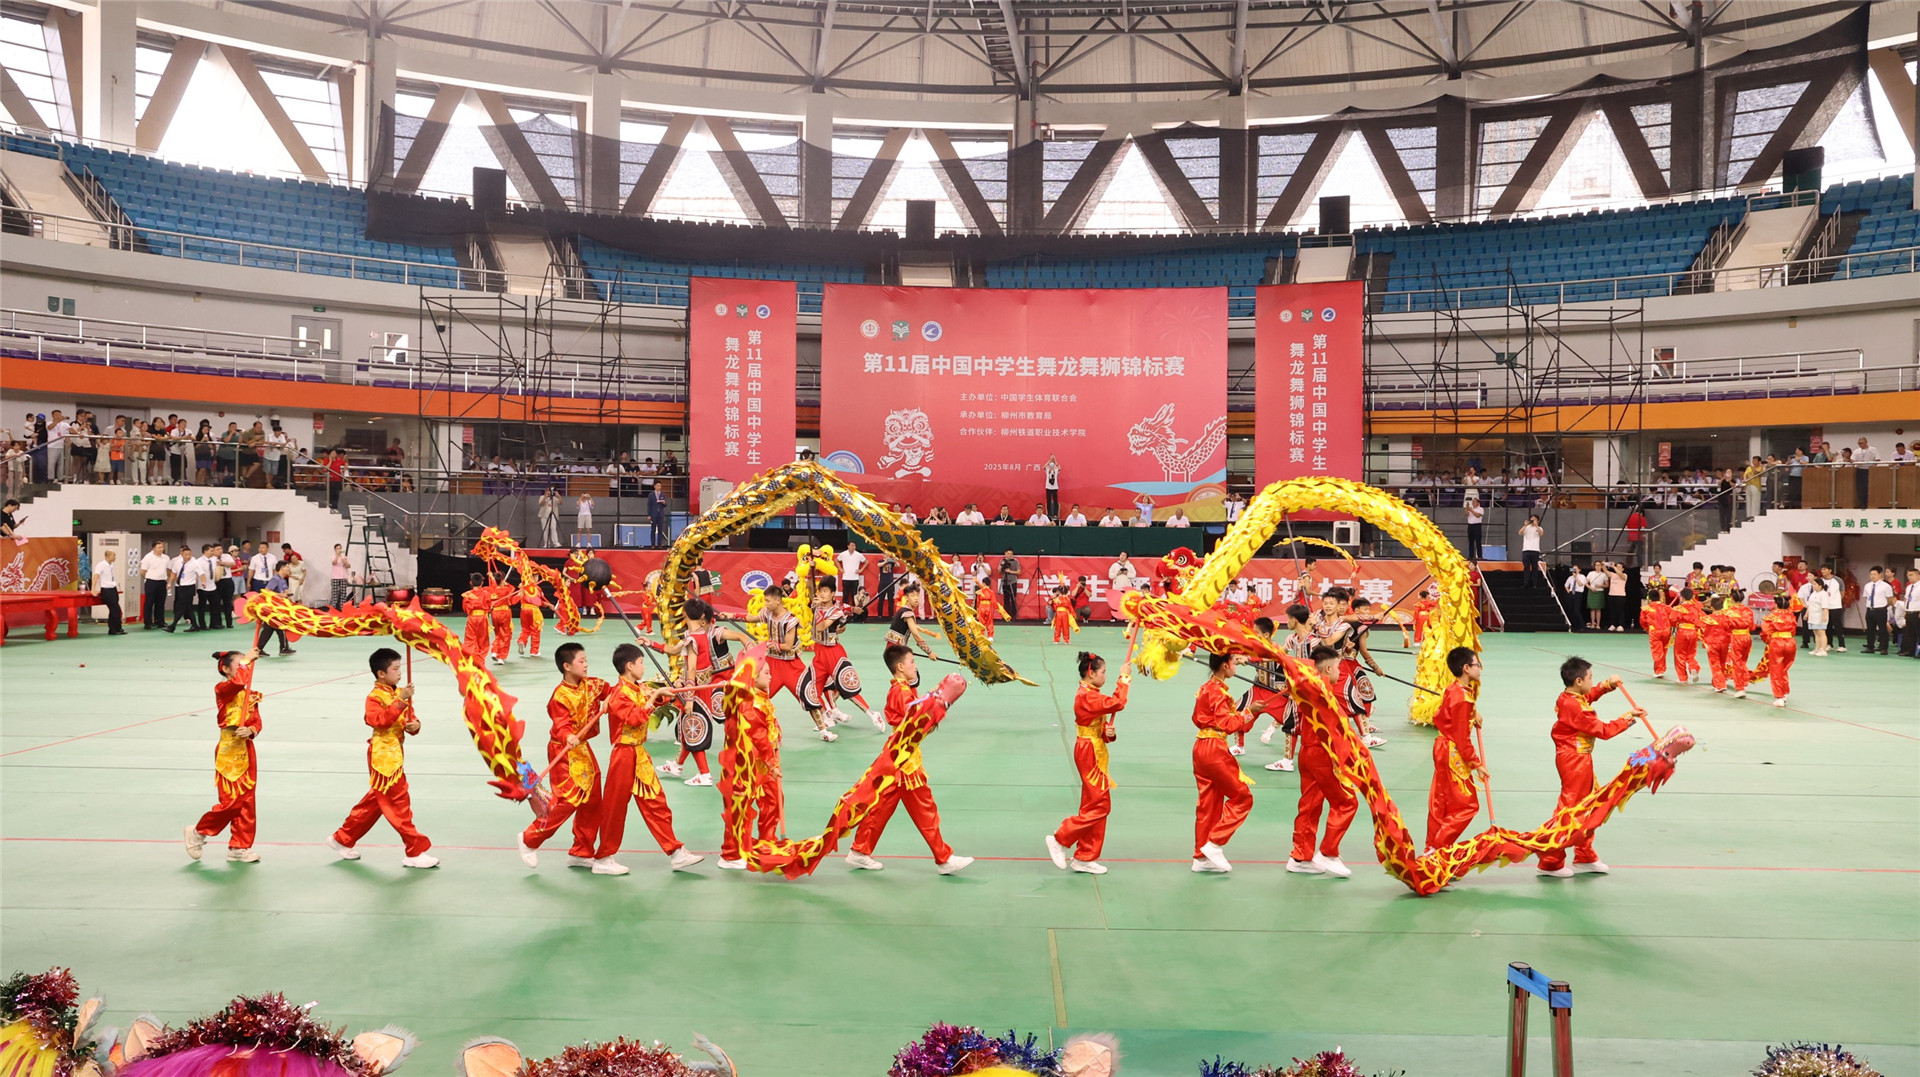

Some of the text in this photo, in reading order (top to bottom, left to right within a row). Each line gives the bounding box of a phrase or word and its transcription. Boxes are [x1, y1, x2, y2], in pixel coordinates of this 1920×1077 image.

[724, 337, 740, 457] 舞龙舞狮锦标赛
[746, 329, 763, 465] 第11届中国中学生
[863, 352, 1185, 377] 第11届中国中学生舞龙舞狮锦标赛
[1289, 342, 1305, 463] 舞龙舞狮锦标赛
[1311, 333, 1328, 471] 第11届中国中学生
